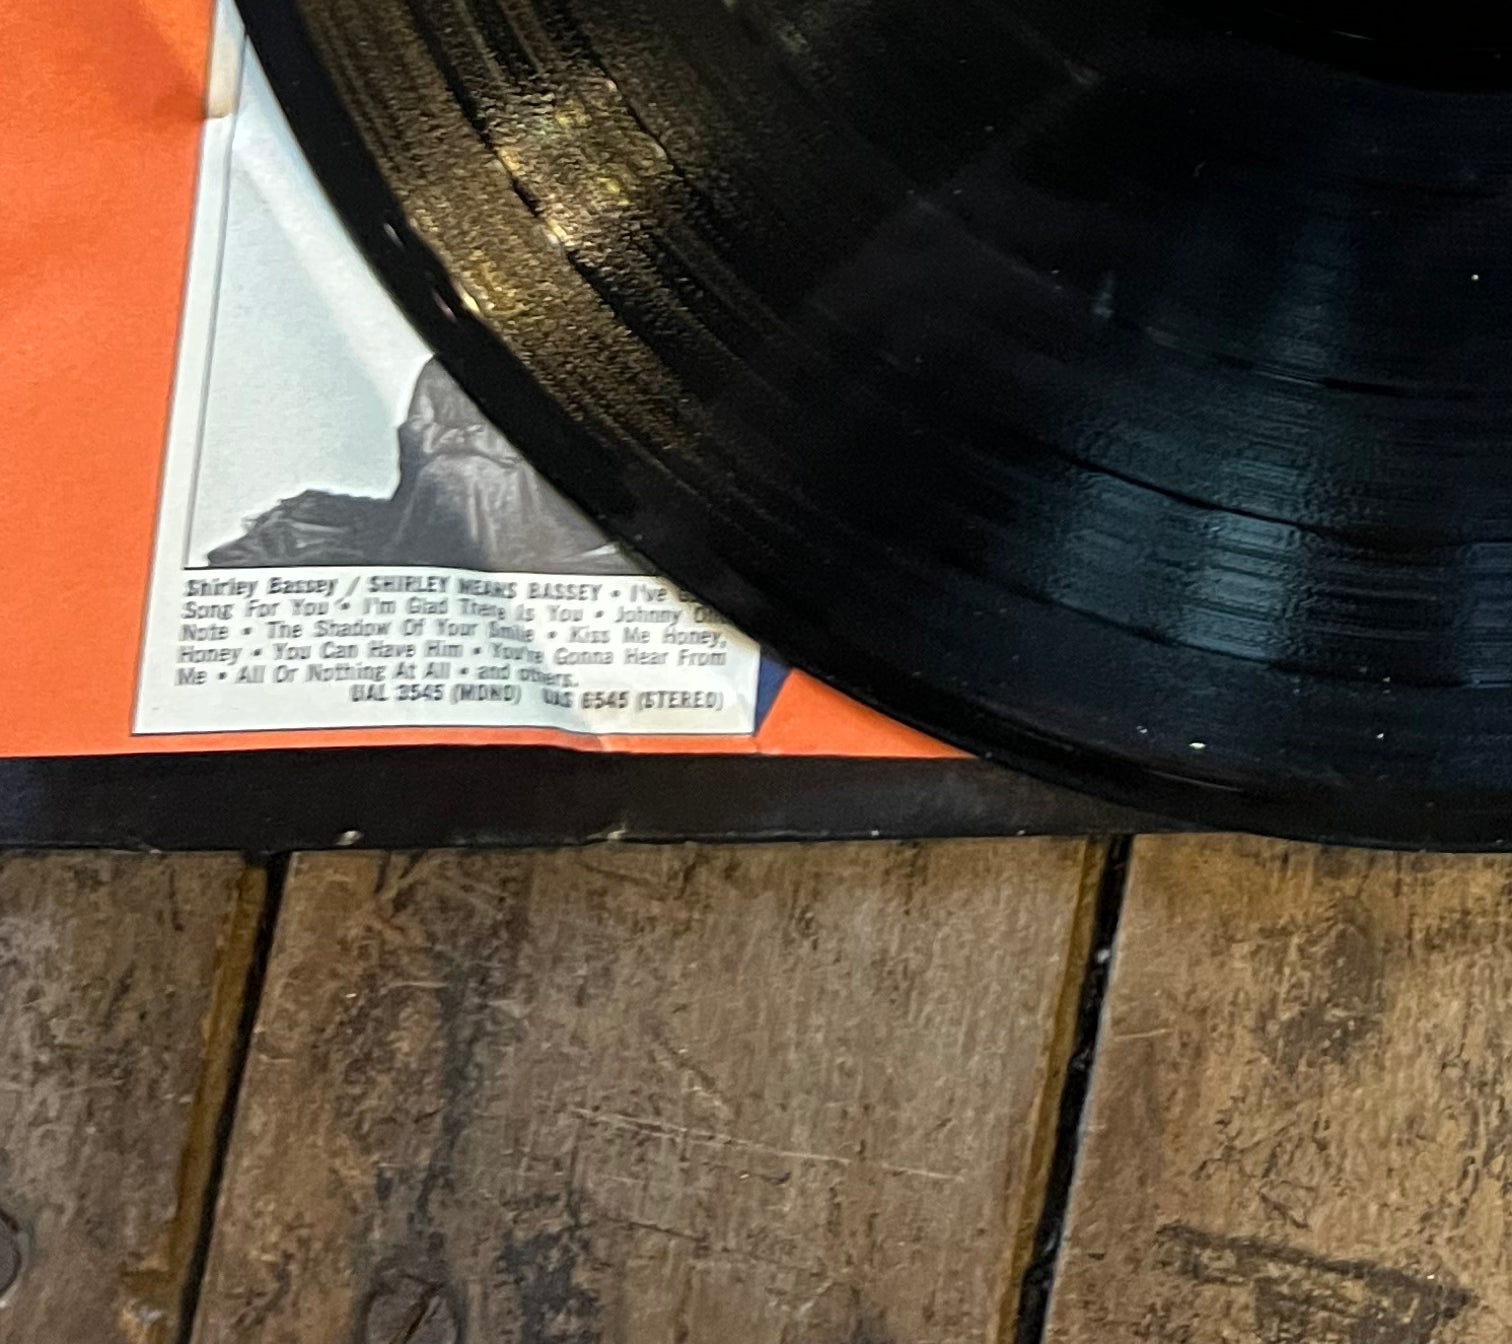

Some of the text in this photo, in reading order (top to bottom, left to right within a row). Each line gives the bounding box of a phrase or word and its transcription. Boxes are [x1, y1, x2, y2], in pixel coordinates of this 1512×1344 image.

[183, 577, 259, 599] Shirley
[266, 576, 339, 597] Bassey
[367, 575, 451, 594] SHIRLEY
[526, 582, 604, 602] BASSEY
[266, 620, 304, 639] The
[312, 619, 392, 639] Shadow
